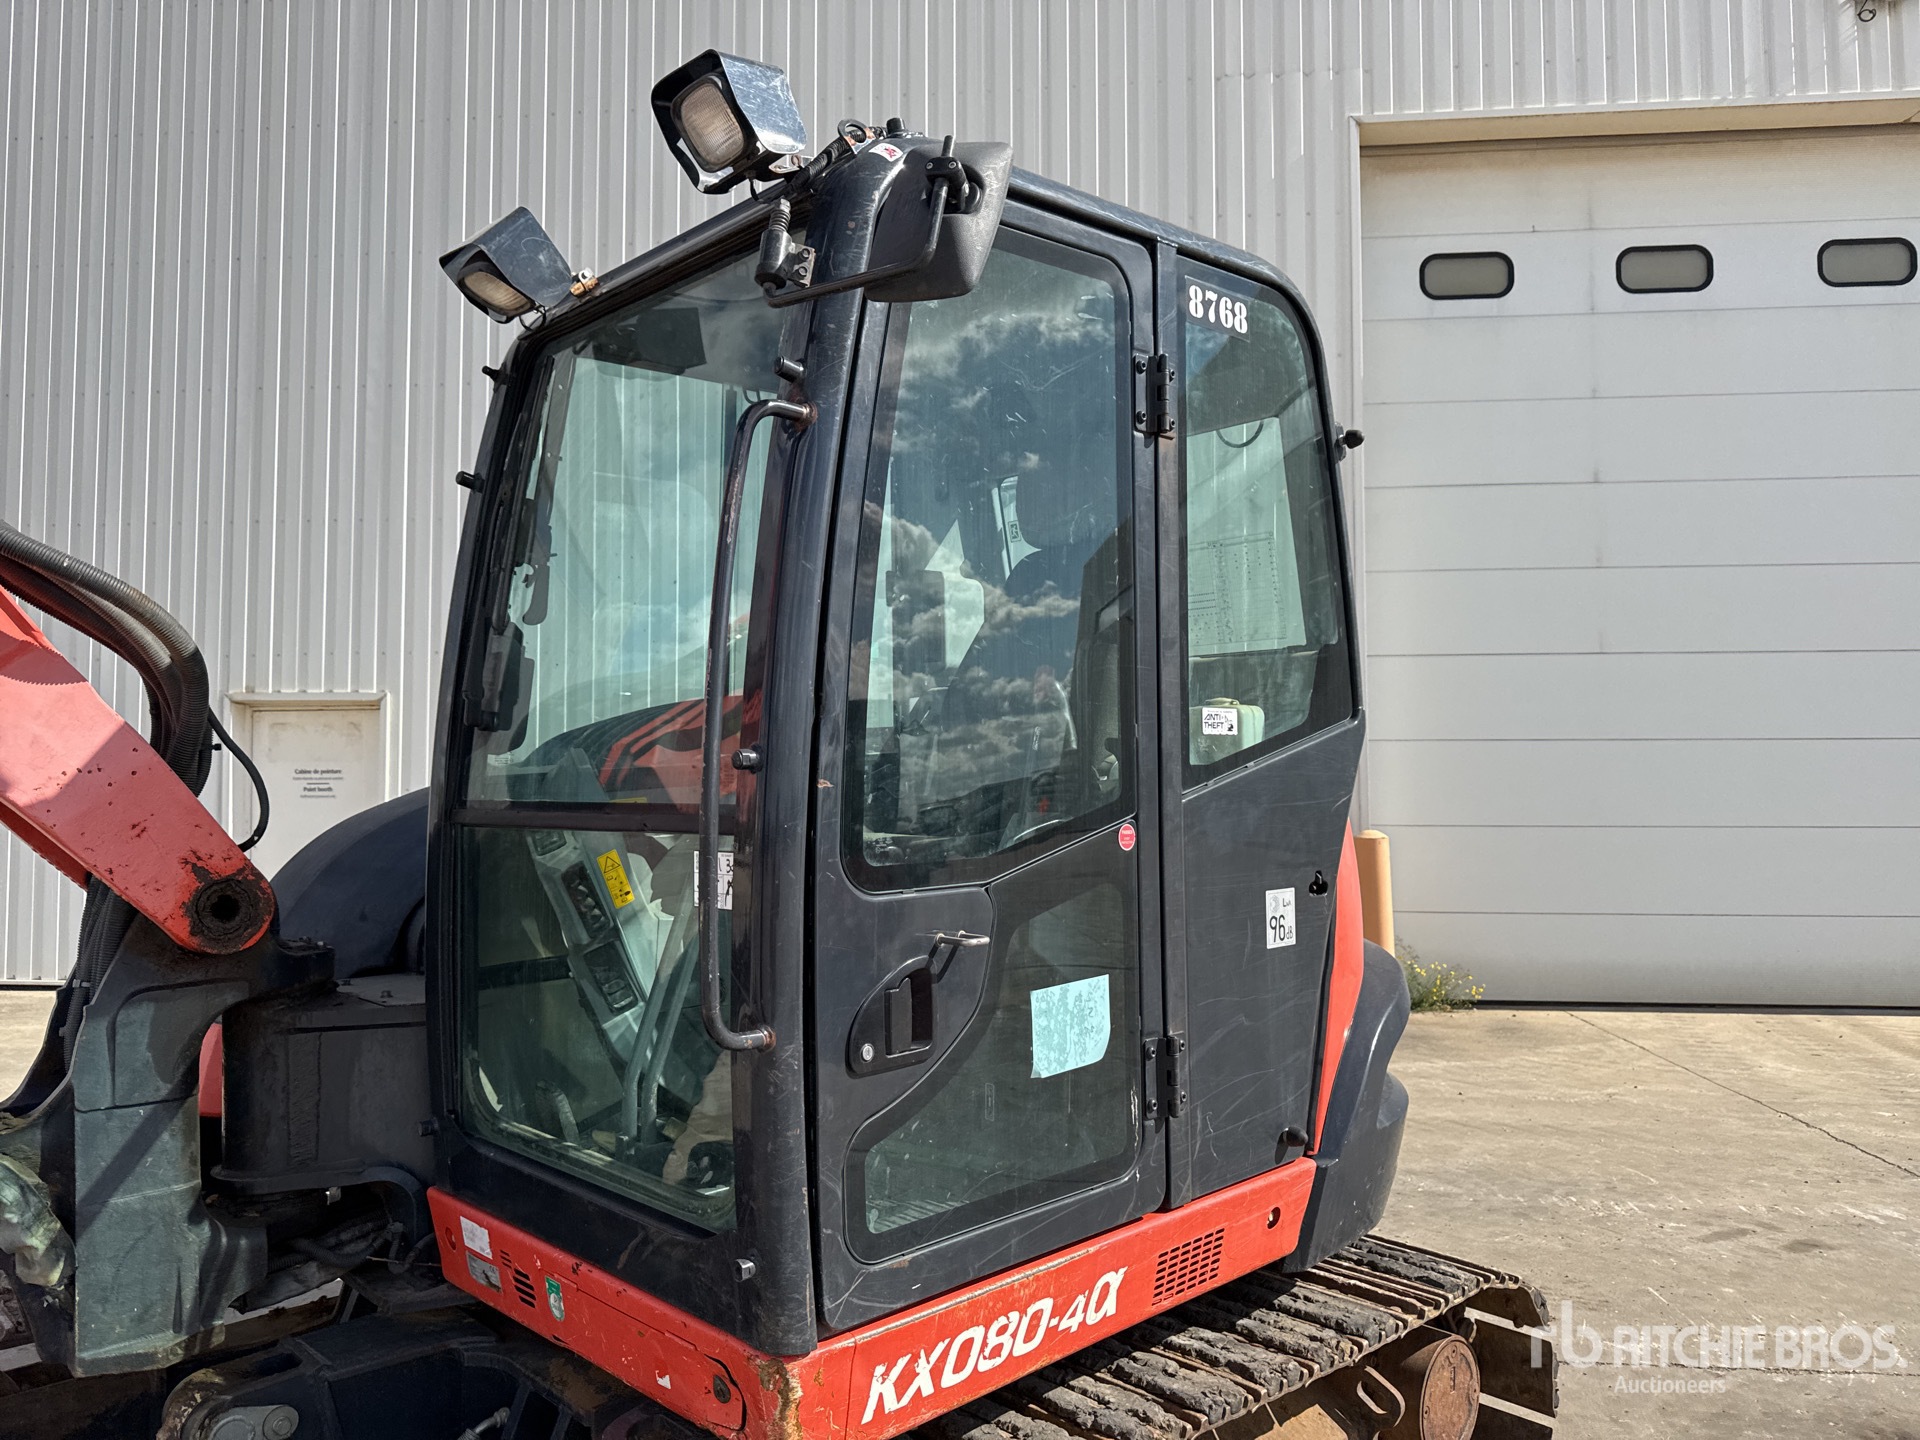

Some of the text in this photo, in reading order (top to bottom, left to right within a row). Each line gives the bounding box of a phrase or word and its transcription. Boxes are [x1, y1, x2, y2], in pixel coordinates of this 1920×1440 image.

[1188, 284, 1248, 334] 8768
[1203, 721, 1225, 729] THEFT
[1269, 914, 1286, 943] 96
